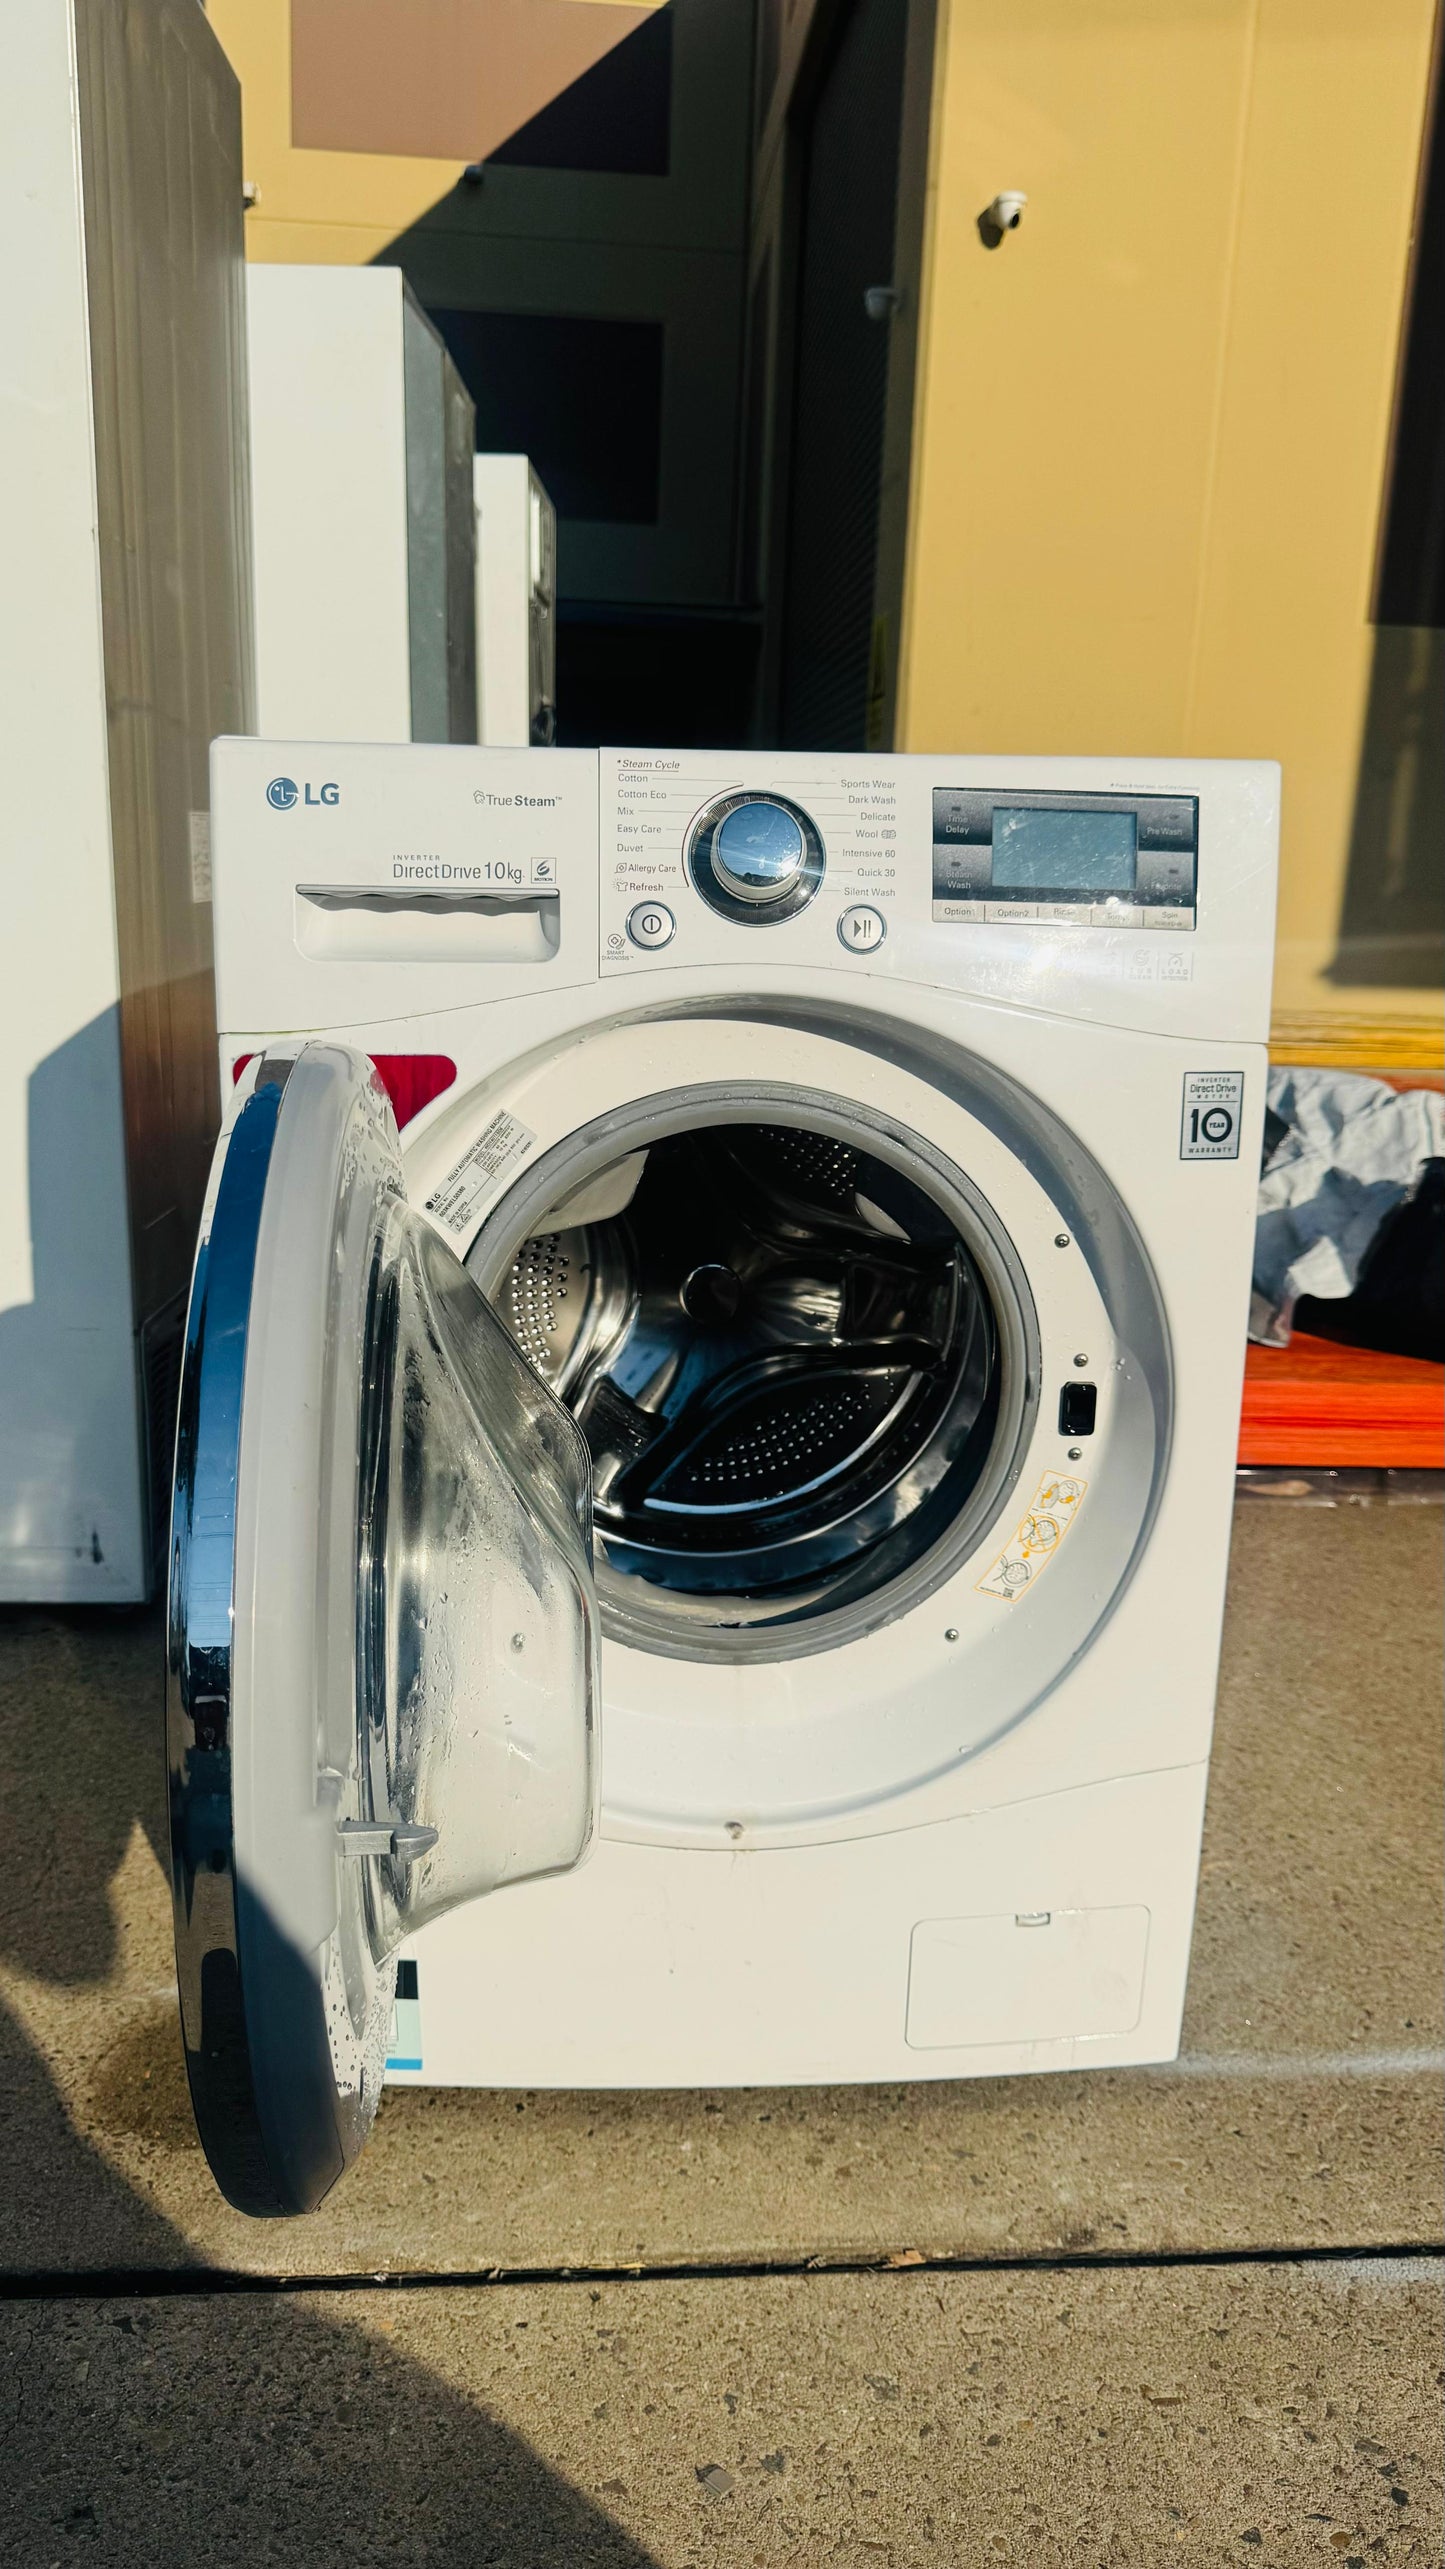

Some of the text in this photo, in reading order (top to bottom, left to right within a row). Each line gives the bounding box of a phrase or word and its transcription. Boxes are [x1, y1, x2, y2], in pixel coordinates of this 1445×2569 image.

[655, 760, 680, 770] Cycle
[618, 774, 648, 783] Cotton
[841, 779, 896, 789] Sports Wear
[304, 783, 340, 806] LG
[618, 790, 667, 799] Cotton Eco
[848, 796, 896, 805] Dark Wash
[617, 807, 634, 816] Mix
[860, 812, 896, 822] Delicate
[617, 825, 662, 835] Easy Care
[856, 830, 878, 838] Wool
[946, 826, 970, 835] Delay
[1146, 826, 1182, 836] Pre Wash
[617, 844, 644, 852] Duvet
[842, 848, 896, 858] Intensive 60
[628, 864, 677, 874] Allergy Care
[857, 868, 896, 878] Quick 30
[629, 882, 664, 892] Refresh
[948, 880, 971, 890] Wash
[844, 887, 896, 897] Silent Wash
[997, 909, 1029, 918] Option2
[1162, 911, 1178, 920] Spin
[1190, 1084, 1237, 1093] Direct Drive
[1190, 1108, 1232, 1143] 10
[447, 1110, 506, 1183] FULLY AUTOMATIC WASHING MACHINE
[431, 1192, 441, 1203] LG
